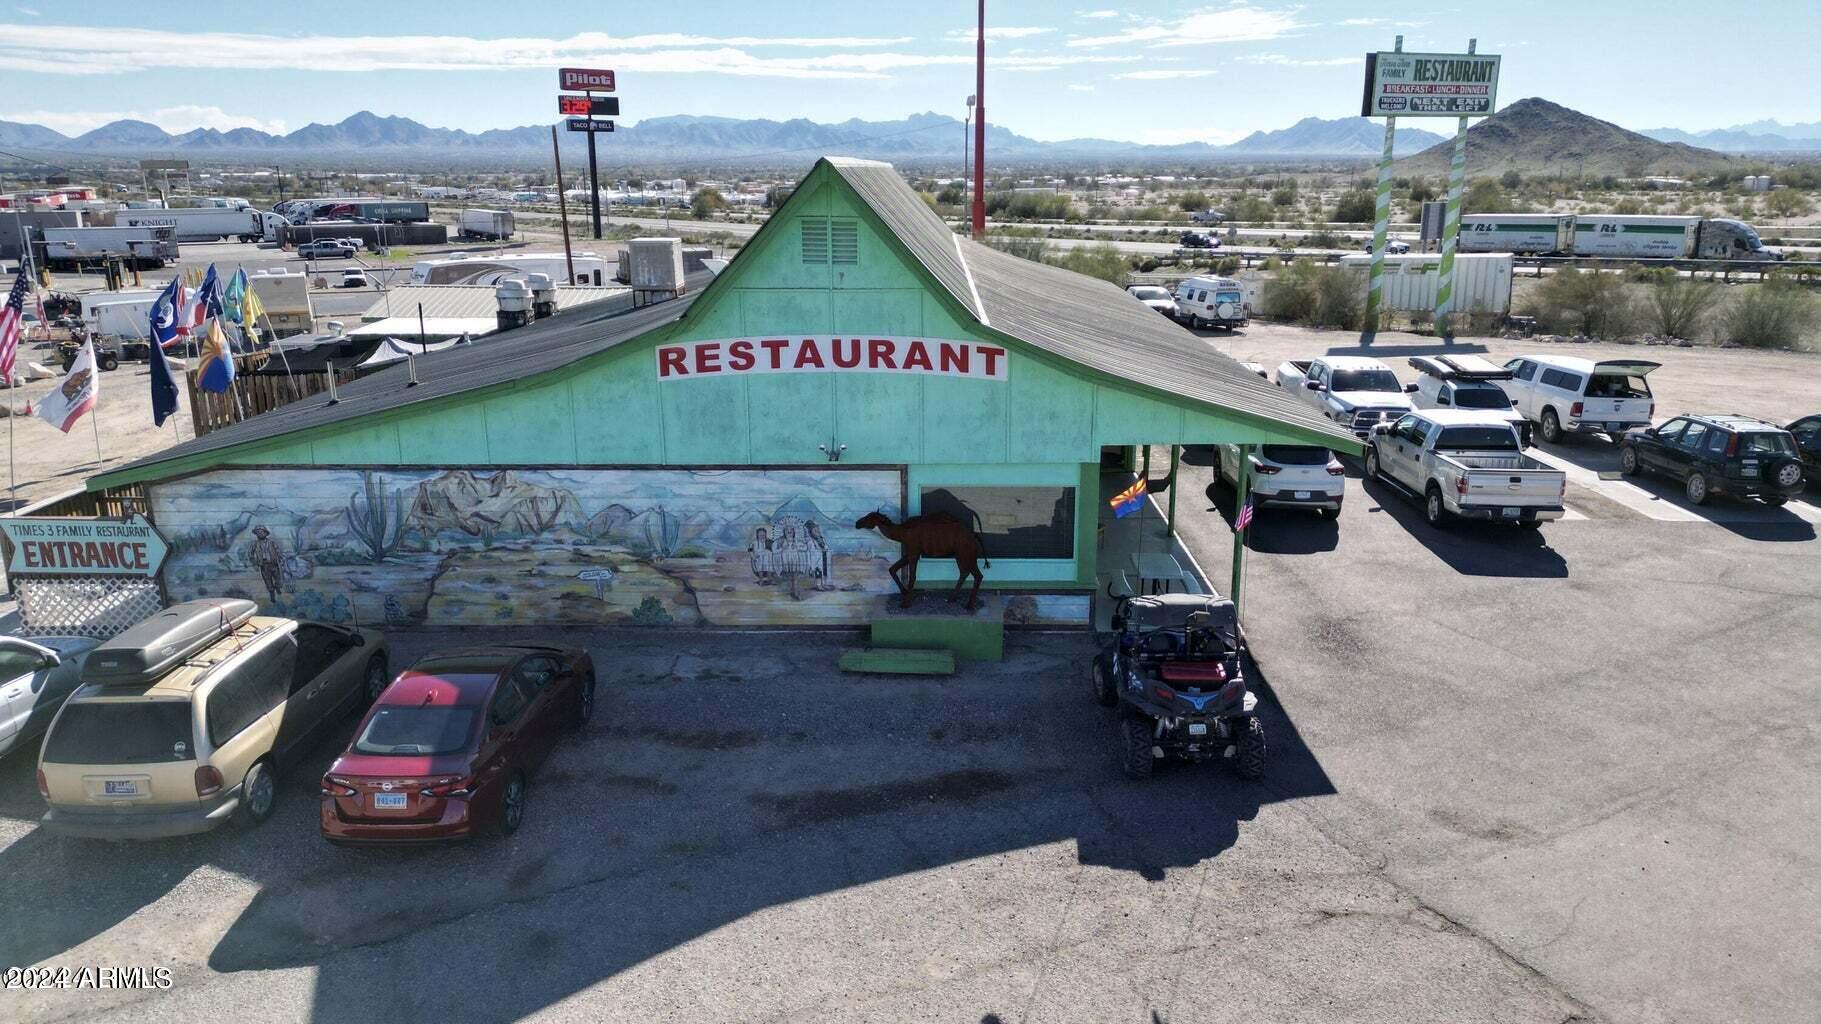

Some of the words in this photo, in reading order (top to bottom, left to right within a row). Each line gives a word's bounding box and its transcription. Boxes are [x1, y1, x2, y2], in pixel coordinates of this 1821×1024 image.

[1382, 68, 1407, 79] FAMILY
[1413, 59, 1496, 82] RESTAURANT
[1386, 85, 1428, 94] BREAKFAST
[1432, 85, 1457, 94] LUNCH
[1460, 86, 1487, 95] DINNER
[1456, 98, 1488, 106] EXIT
[658, 339, 1005, 377] RESTAURANT
[10, 524, 45, 537] TIMES
[49, 524, 55, 537] 3
[56, 525, 92, 537] FAMILY
[96, 525, 150, 538] RESTAURANT
[22, 541, 150, 570] ENTRANCE
